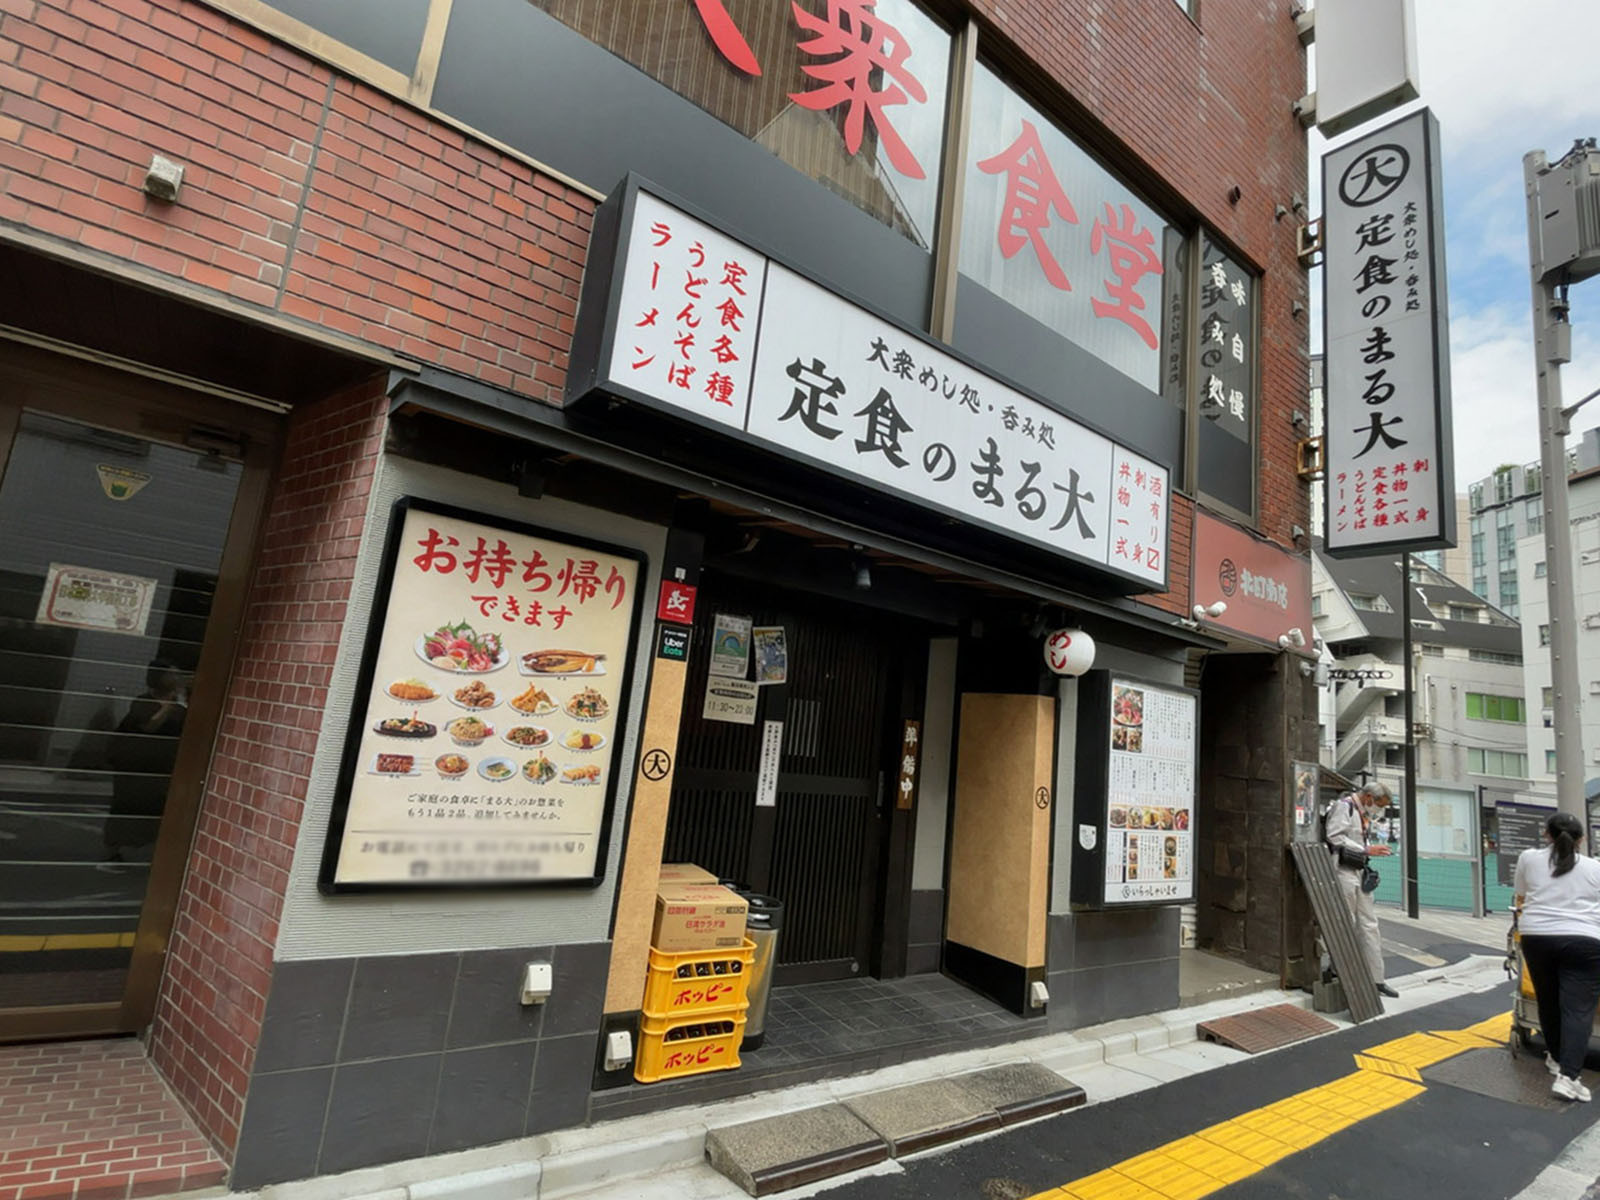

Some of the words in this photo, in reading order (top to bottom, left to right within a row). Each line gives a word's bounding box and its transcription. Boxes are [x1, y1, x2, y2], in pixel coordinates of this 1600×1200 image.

[631, 221, 672, 370] ラーメン
[667, 241, 708, 390] うどんそば
[703, 261, 748, 407] 定食各種
[1208, 262, 1227, 407] 呑み処
[1228, 279, 1246, 421] 味自慢
[1352, 212, 1408, 460] 定食のまる大
[865, 336, 1057, 451] 大衆めし処・呑み処
[777, 356, 1097, 540] 定食のまる大
[1114, 461, 1131, 560] 丼物一式
[1131, 469, 1146, 563] 刺身
[1336, 472, 1348, 532] ラーメン
[1353, 469, 1368, 530] うどんそば
[1372, 466, 1389, 528] 定食各種
[1392, 462, 1409, 524] 丼物一式
[1412, 458, 1430, 522] 刺身
[413, 527, 627, 611] お持ち帰り
[471, 594, 574, 631] できます
[664, 636, 684, 648] Uber
[663, 646, 683, 657] Eats
[1049, 630, 1072, 669] めし
[645, 753, 667, 776] 大
[901, 726, 918, 800] 準備中
[674, 982, 734, 1006] ホッピー
[664, 1043, 725, 1069] ホッピー
